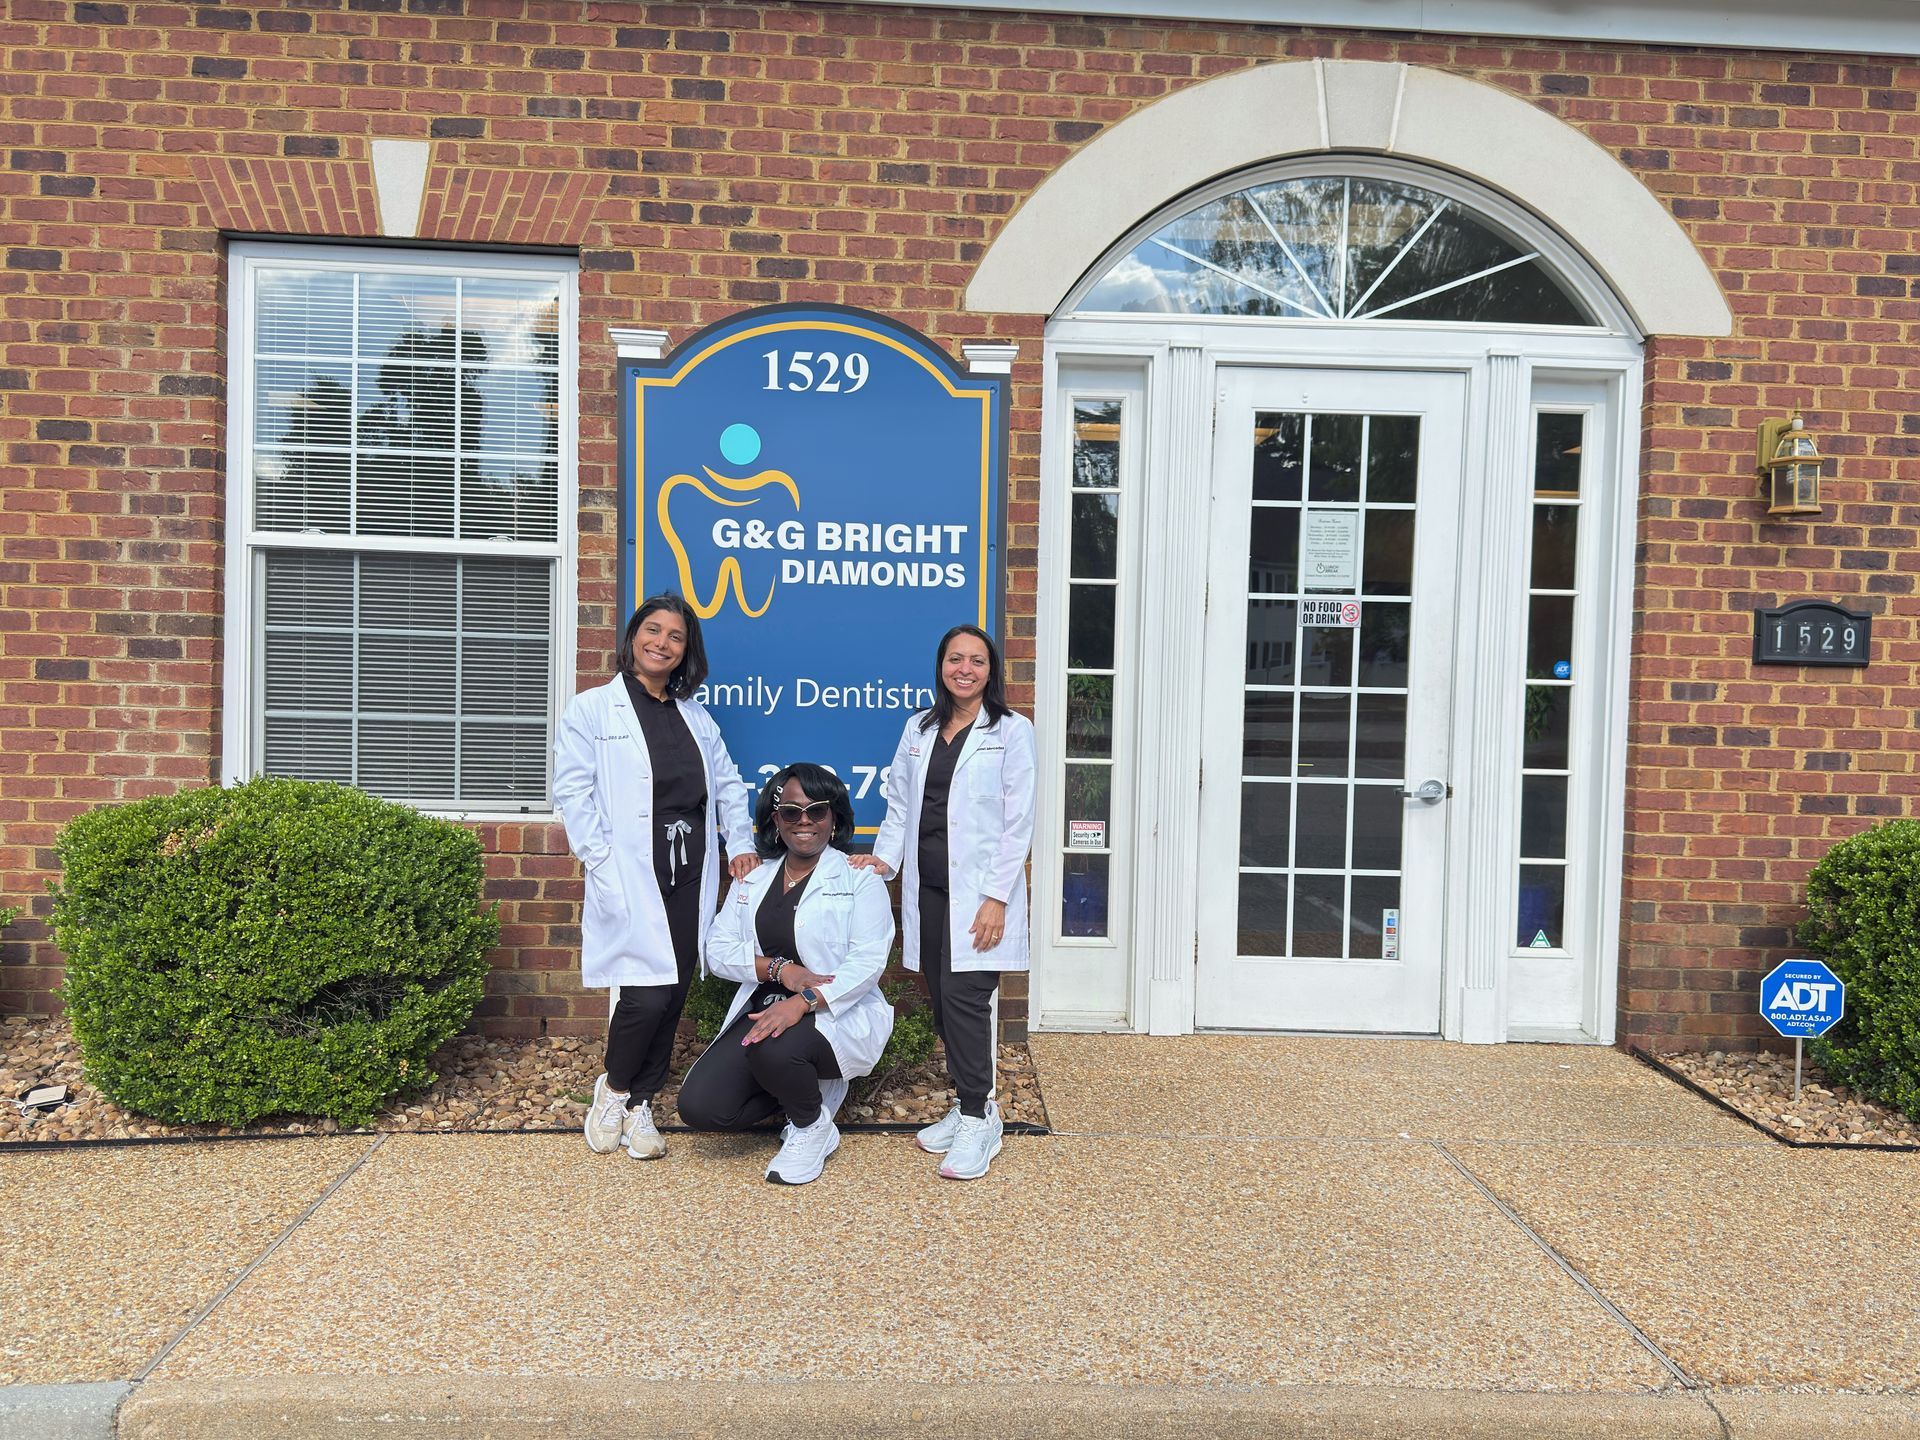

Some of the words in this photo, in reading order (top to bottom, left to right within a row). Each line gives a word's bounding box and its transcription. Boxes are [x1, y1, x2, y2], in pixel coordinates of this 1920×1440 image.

[762, 349, 869, 393] 1529
[712, 518, 805, 550] G&G
[817, 521, 968, 554] BRIGHT
[782, 559, 966, 588] DIAMONDS
[1302, 613, 1314, 624] OR
[1316, 613, 1342, 624] DRINK
[1303, 601, 1316, 612] NO
[1318, 602, 1342, 613] FOOD
[1776, 625, 1856, 651] 1529
[693, 676, 784, 715] amily
[1769, 982, 1836, 1012] ADT
[1770, 1013, 1832, 1023] 800.ADT.ASAP
